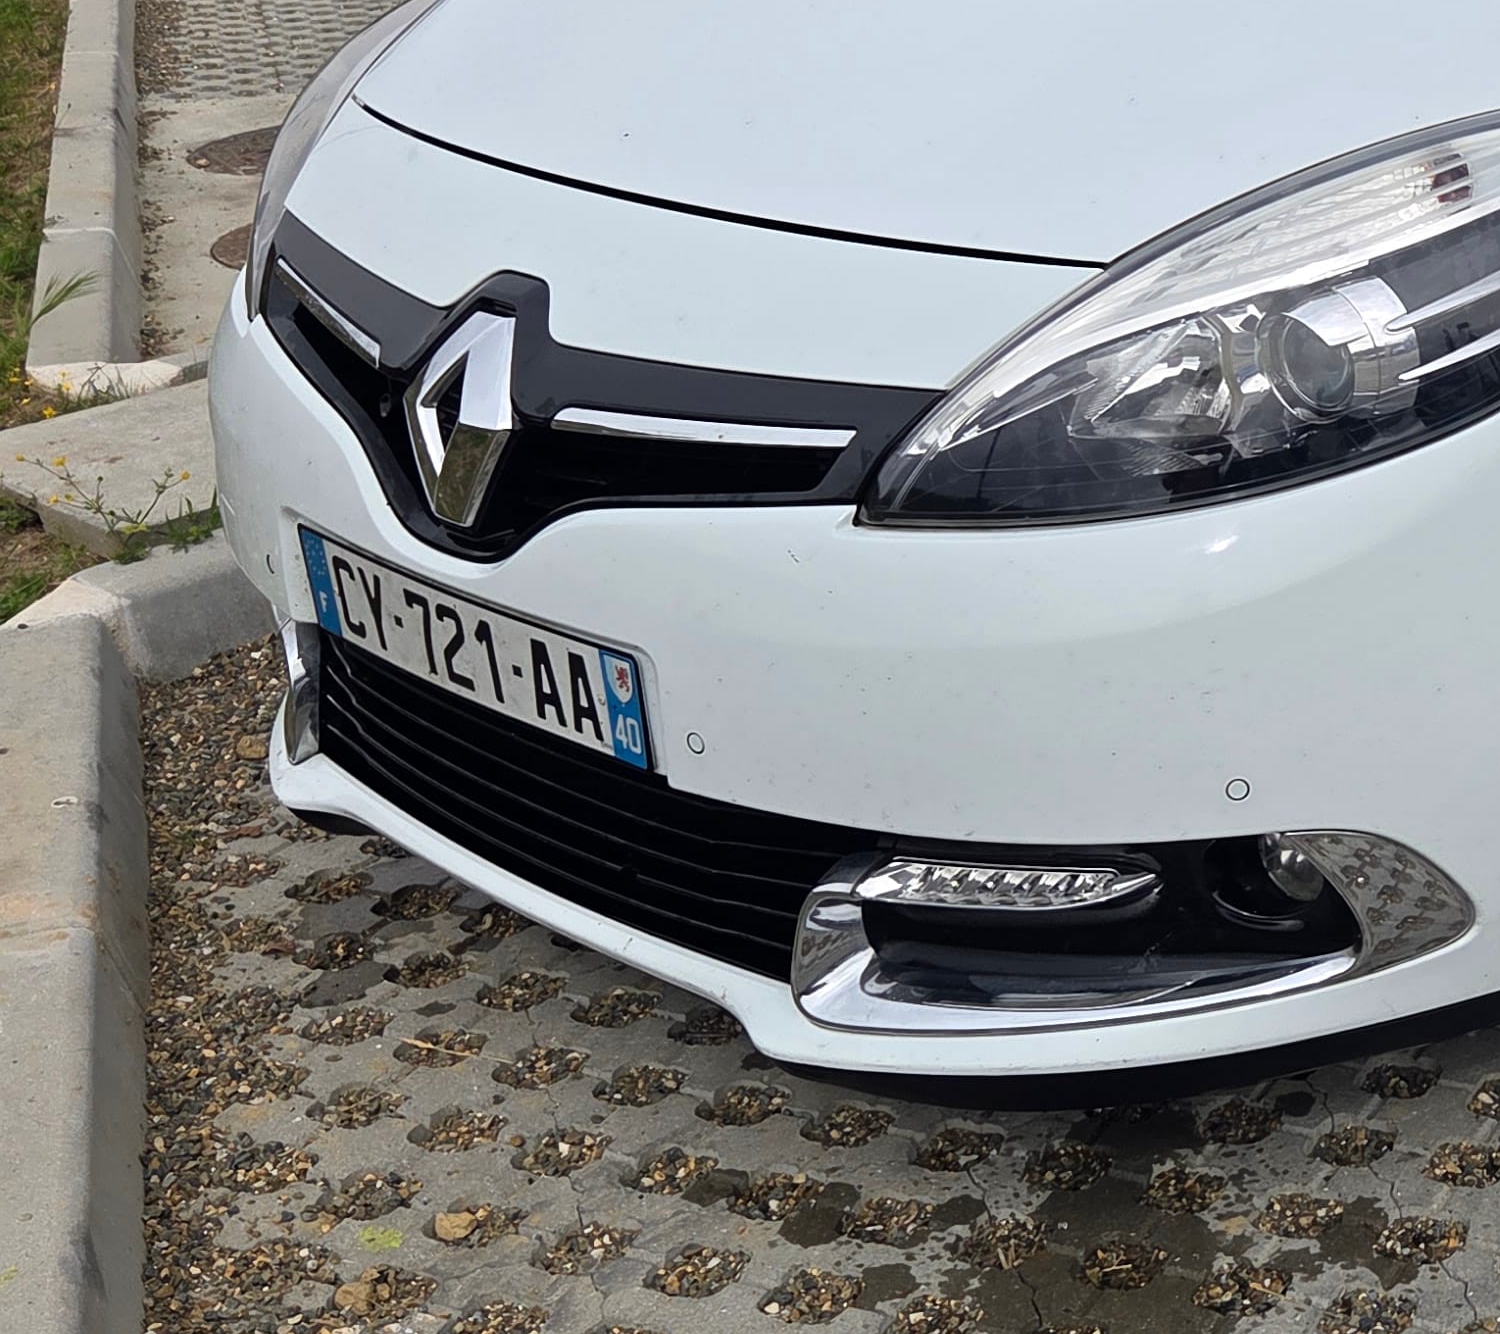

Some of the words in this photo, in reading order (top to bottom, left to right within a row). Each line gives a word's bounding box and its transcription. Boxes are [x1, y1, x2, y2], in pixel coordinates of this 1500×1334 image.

[319, 590, 329, 613] F
[332, 555, 605, 743] CY-721-AA
[615, 713, 642, 755] 40
